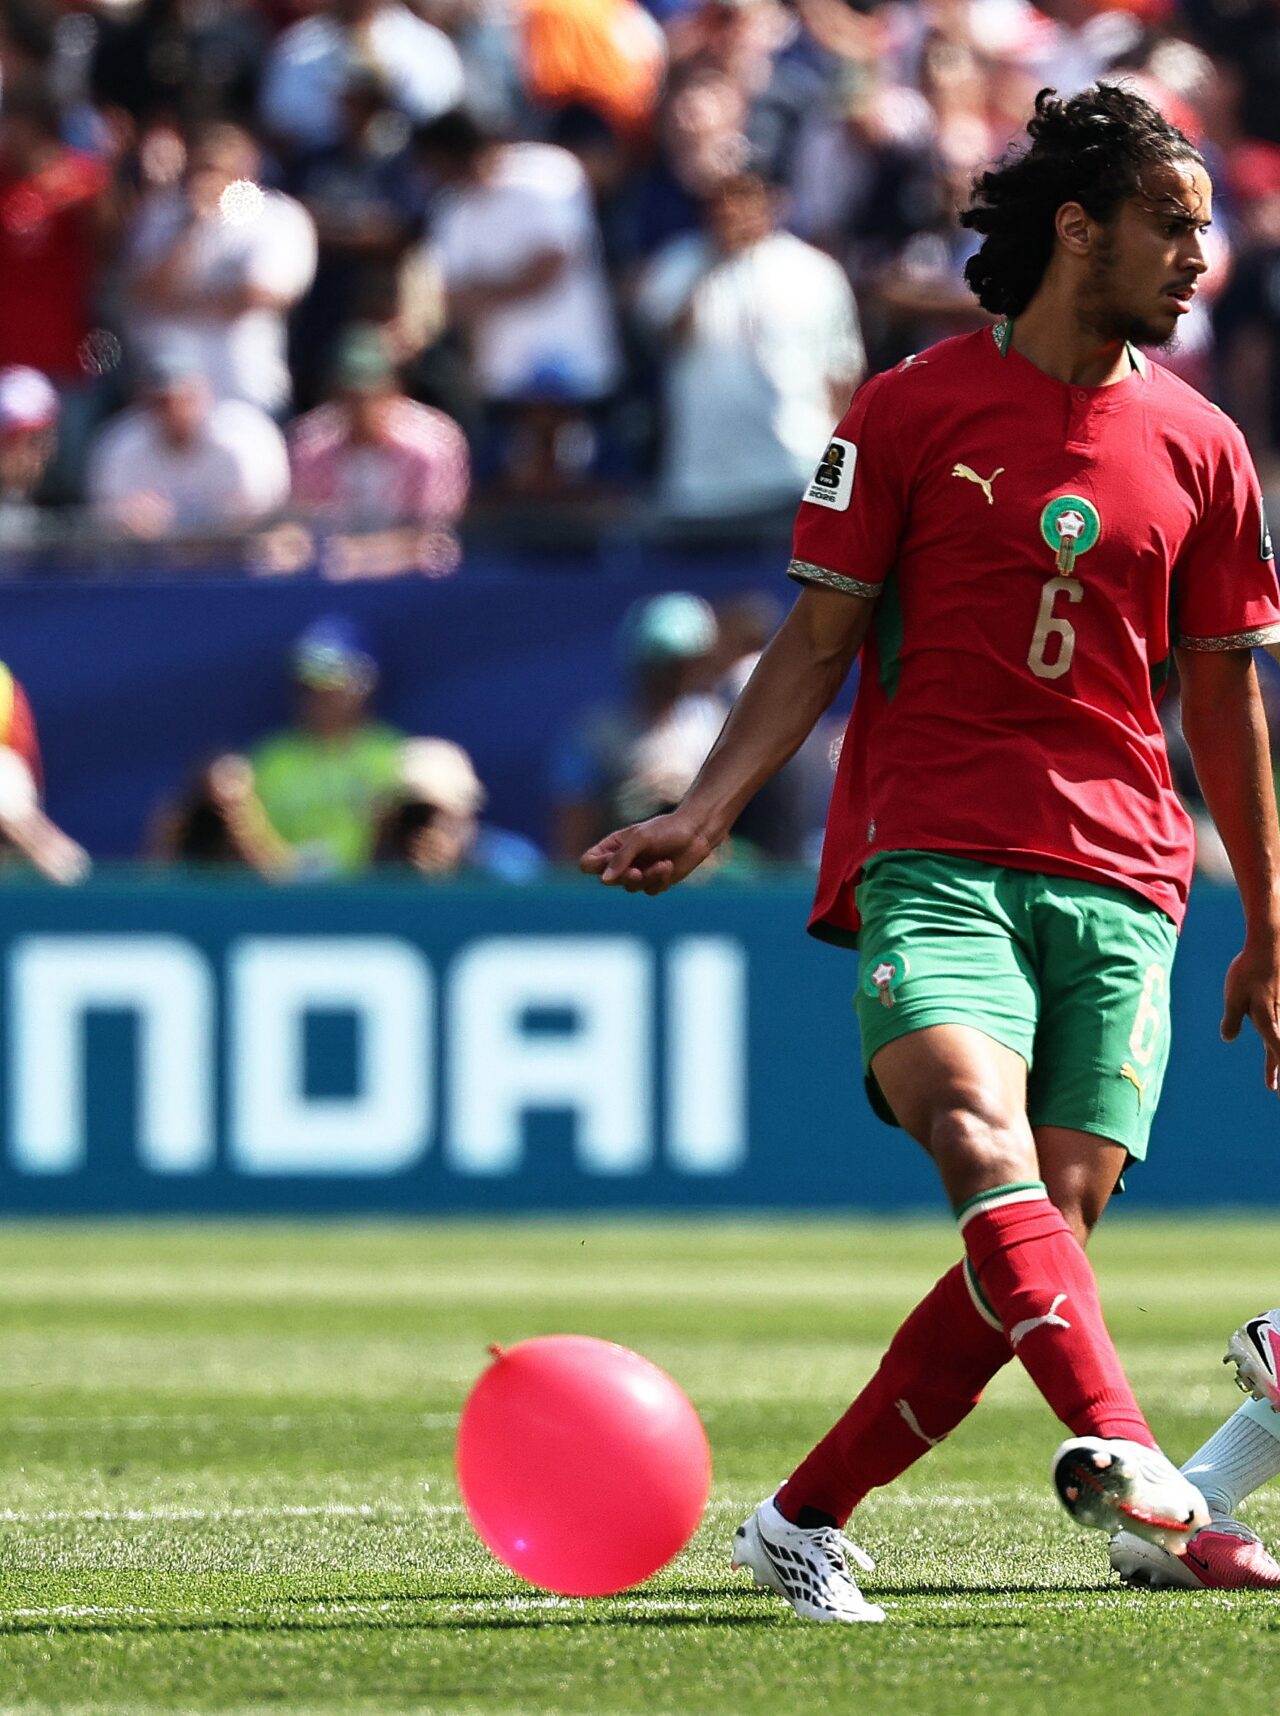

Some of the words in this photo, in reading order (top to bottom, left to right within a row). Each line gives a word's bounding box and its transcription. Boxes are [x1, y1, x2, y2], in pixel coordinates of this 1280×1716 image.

[808, 489, 837, 503] 2026
[1027, 576, 1084, 679] 6
[10, 935, 749, 1174] NDAI
[1128, 963, 1166, 1066] 6
